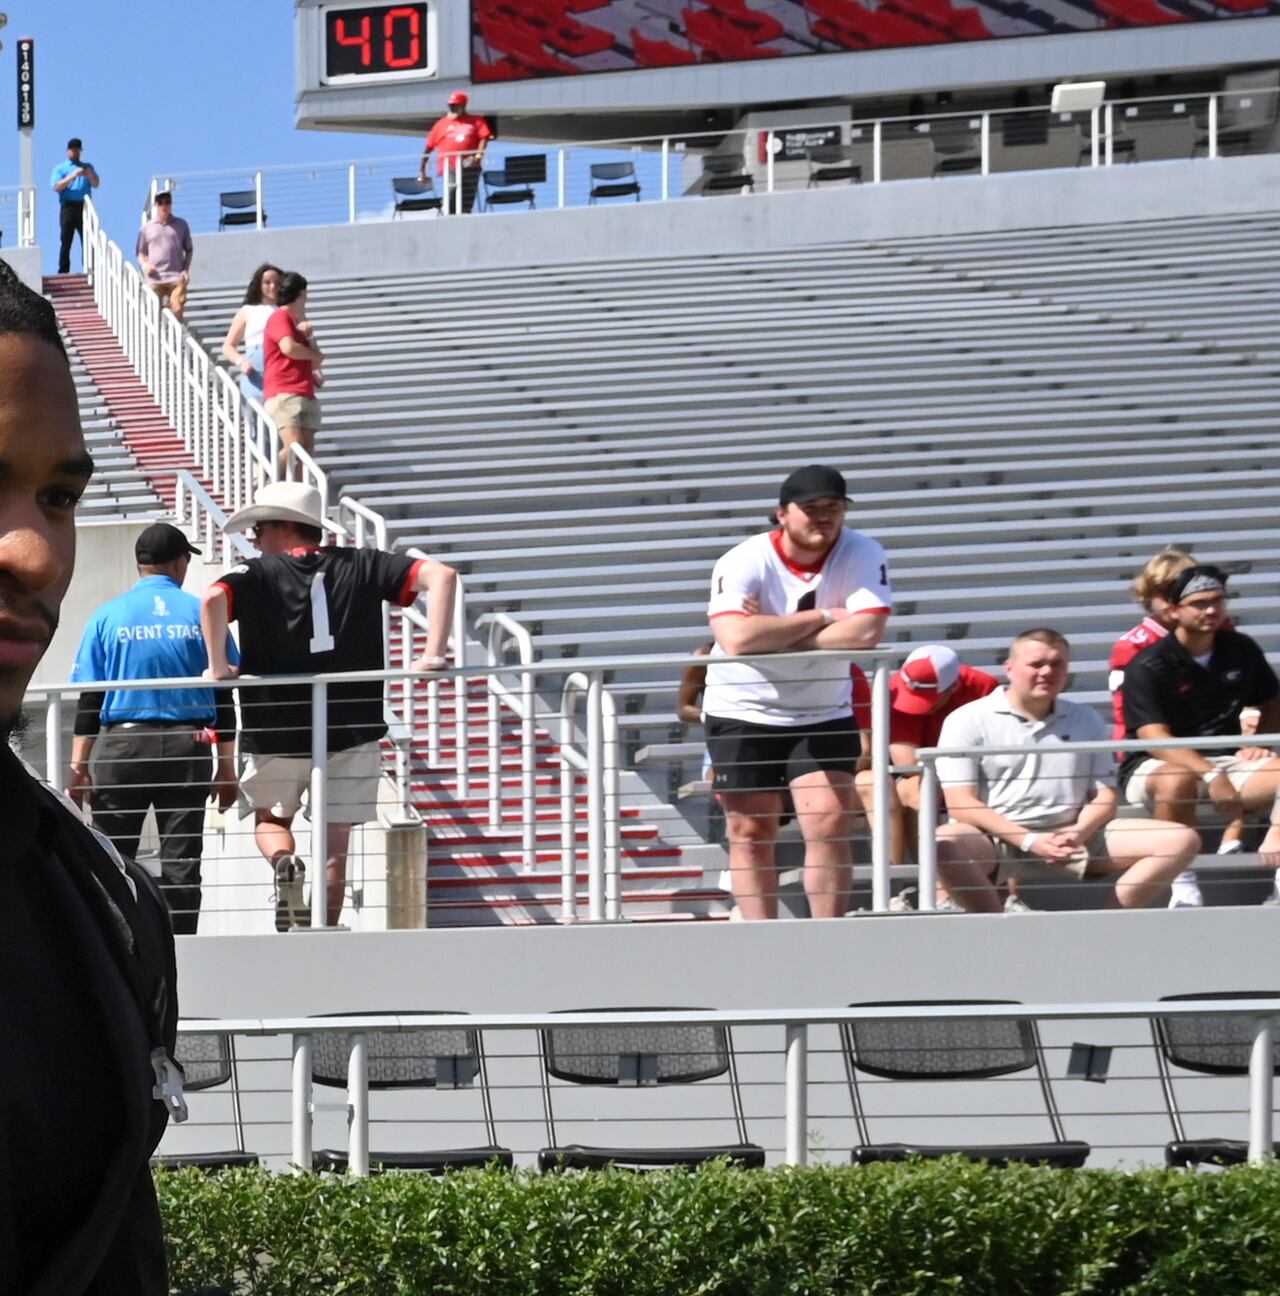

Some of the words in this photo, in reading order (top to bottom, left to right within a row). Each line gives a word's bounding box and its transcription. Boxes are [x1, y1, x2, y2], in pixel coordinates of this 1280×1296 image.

[335, 7, 420, 68] 40
[21, 51, 30, 82] 140
[21, 92, 30, 123] 139
[309, 571, 335, 654] 1
[117, 624, 164, 644] EVENT
[165, 624, 203, 642] STAF
